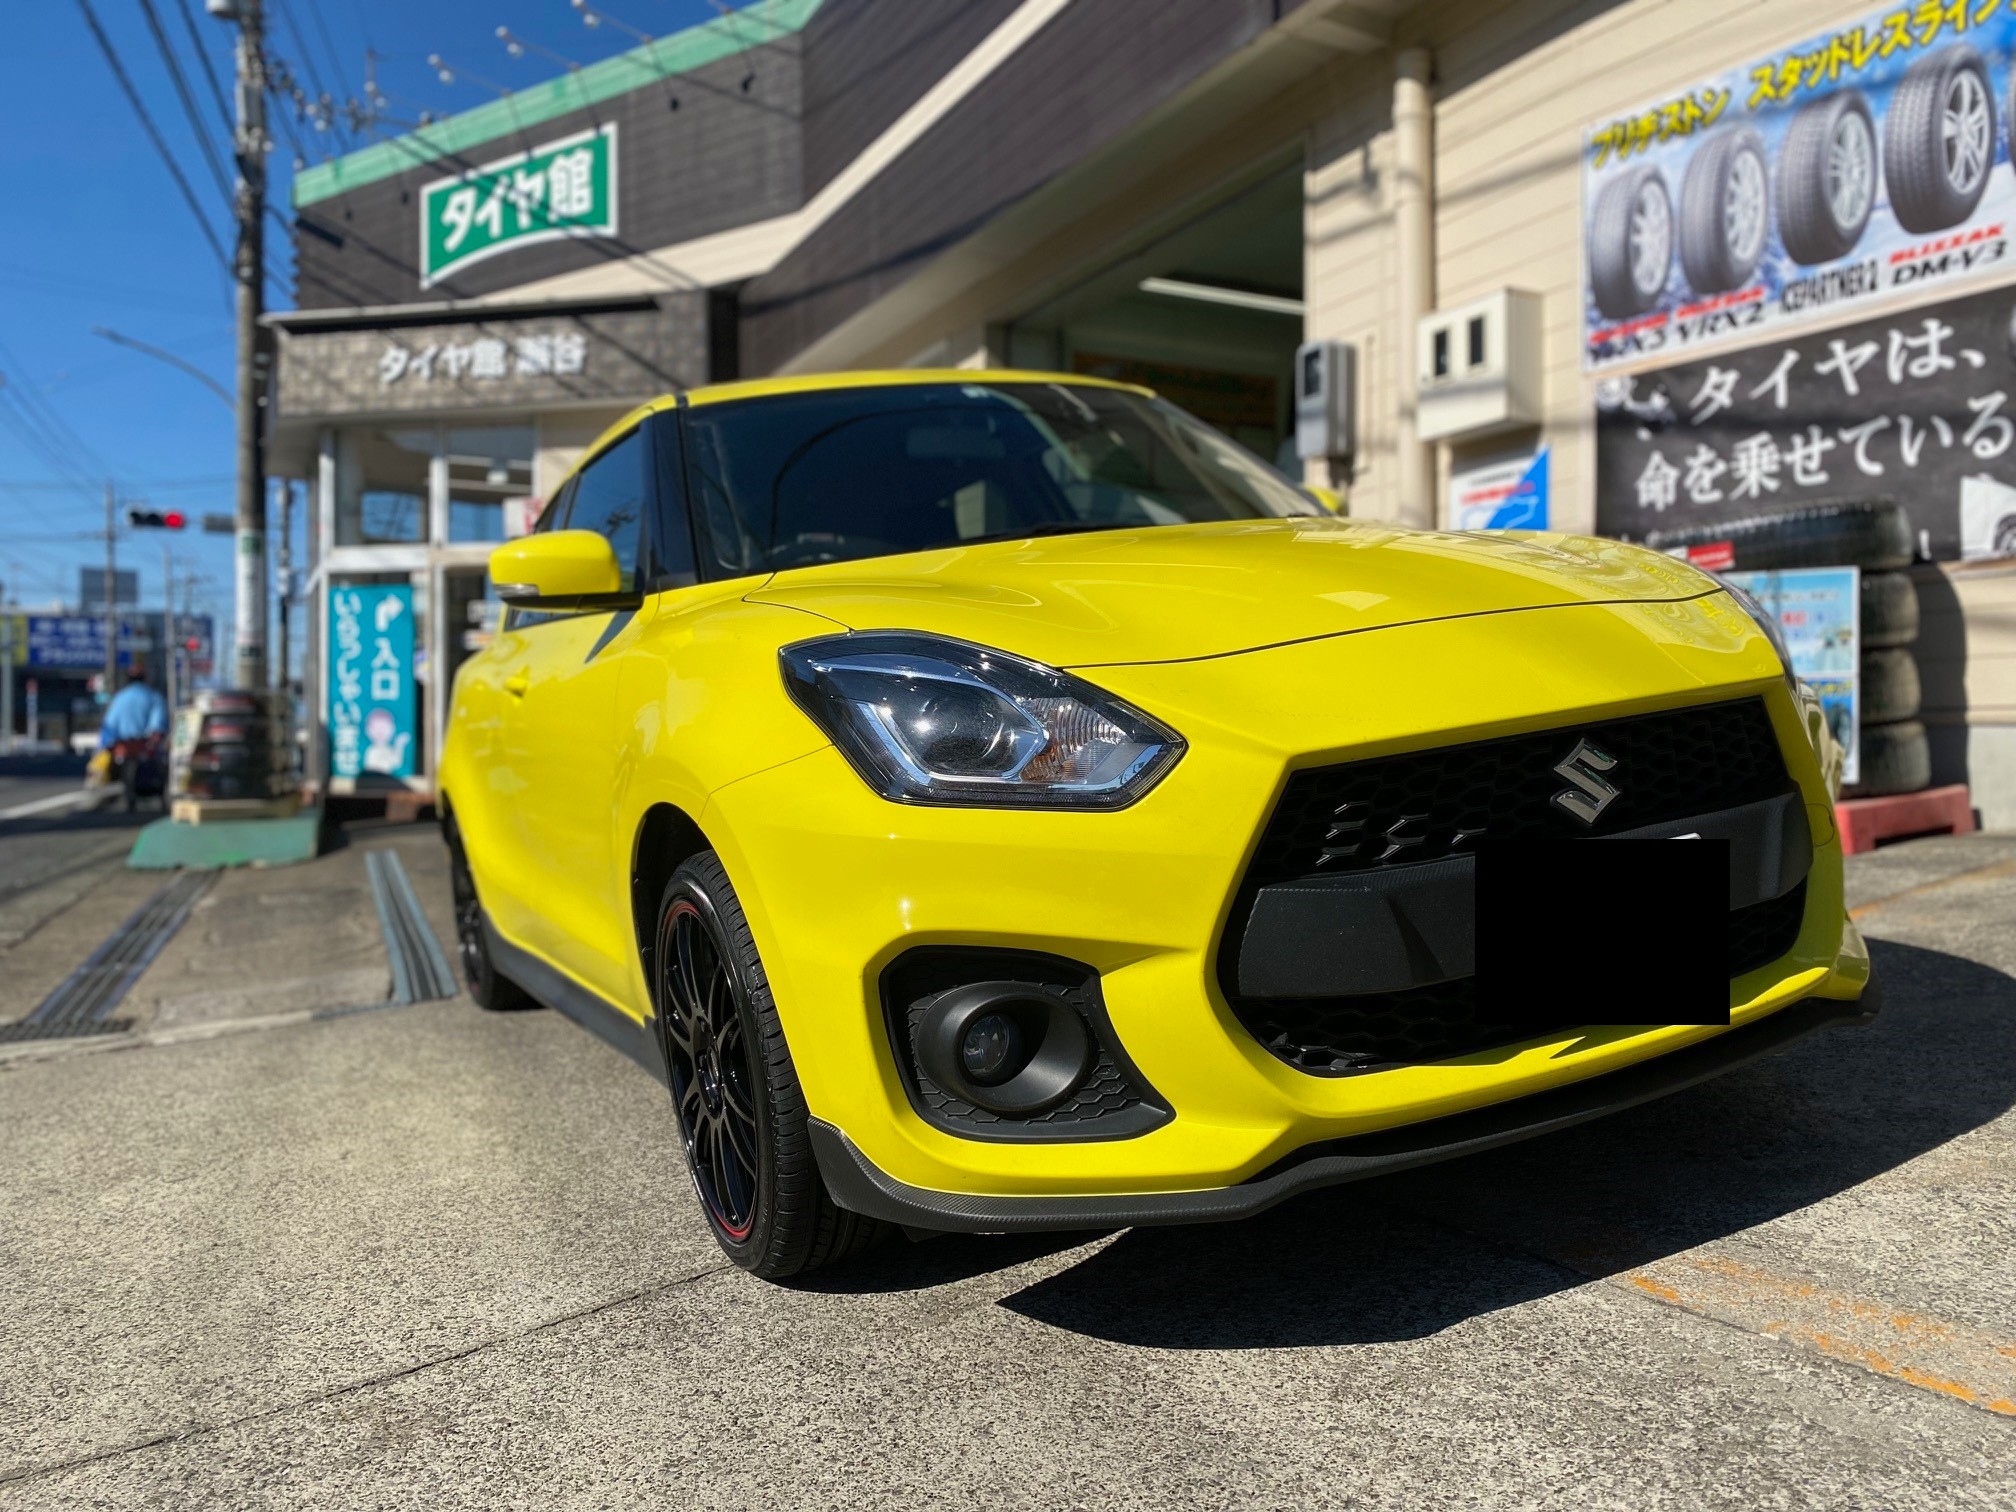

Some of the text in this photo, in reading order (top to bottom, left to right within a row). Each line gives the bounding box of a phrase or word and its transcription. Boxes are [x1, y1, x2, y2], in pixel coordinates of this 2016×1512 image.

[440, 148, 594, 252] タイヤ館
[1893, 240, 2008, 286] DM-V3
[379, 337, 507, 386] タイヤ館
[1634, 390, 2014, 512] 命を乗せている
[333, 591, 363, 777] いらっしゃいませ
[370, 637, 400, 701] 入口
